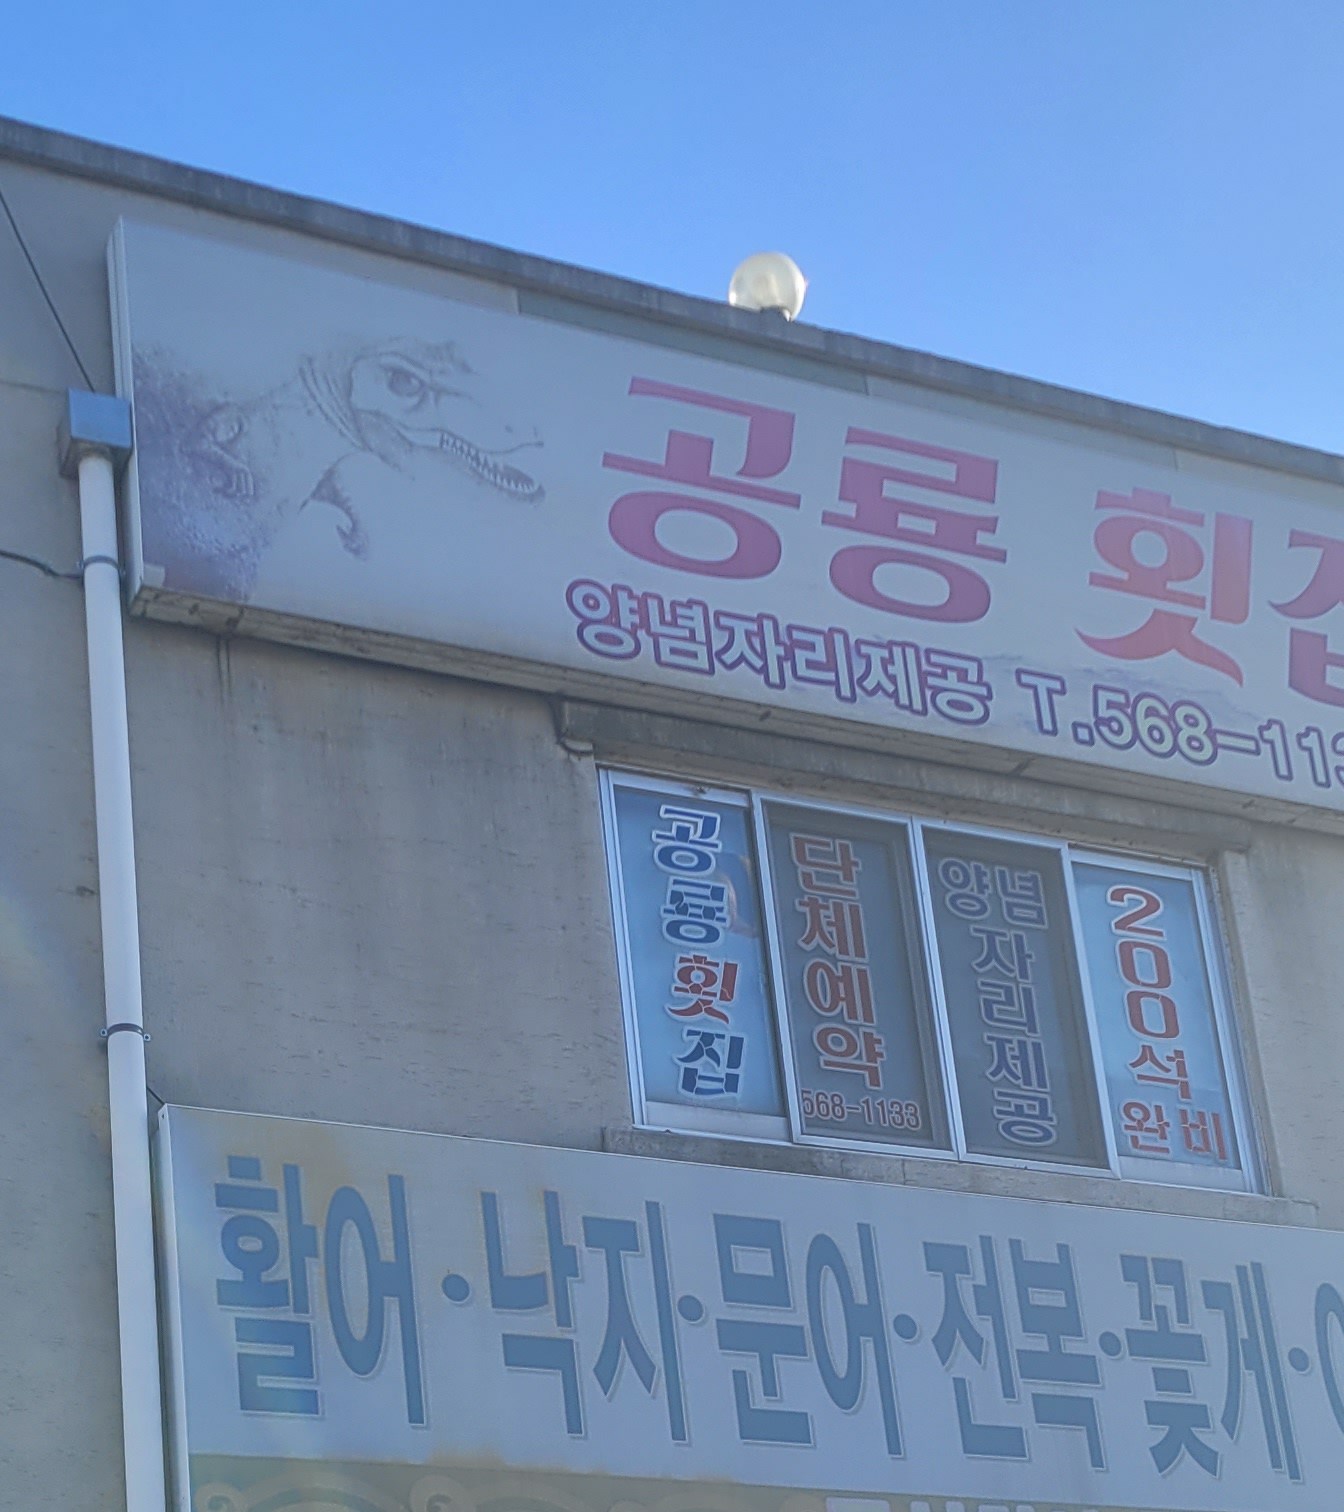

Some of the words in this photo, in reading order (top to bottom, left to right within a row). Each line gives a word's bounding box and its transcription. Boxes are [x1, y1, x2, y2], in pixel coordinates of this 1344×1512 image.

[601, 375, 1008, 625] 공룡
[565, 580, 993, 727] 양념자리제공
[801, 1087, 922, 1131] 568-1133
